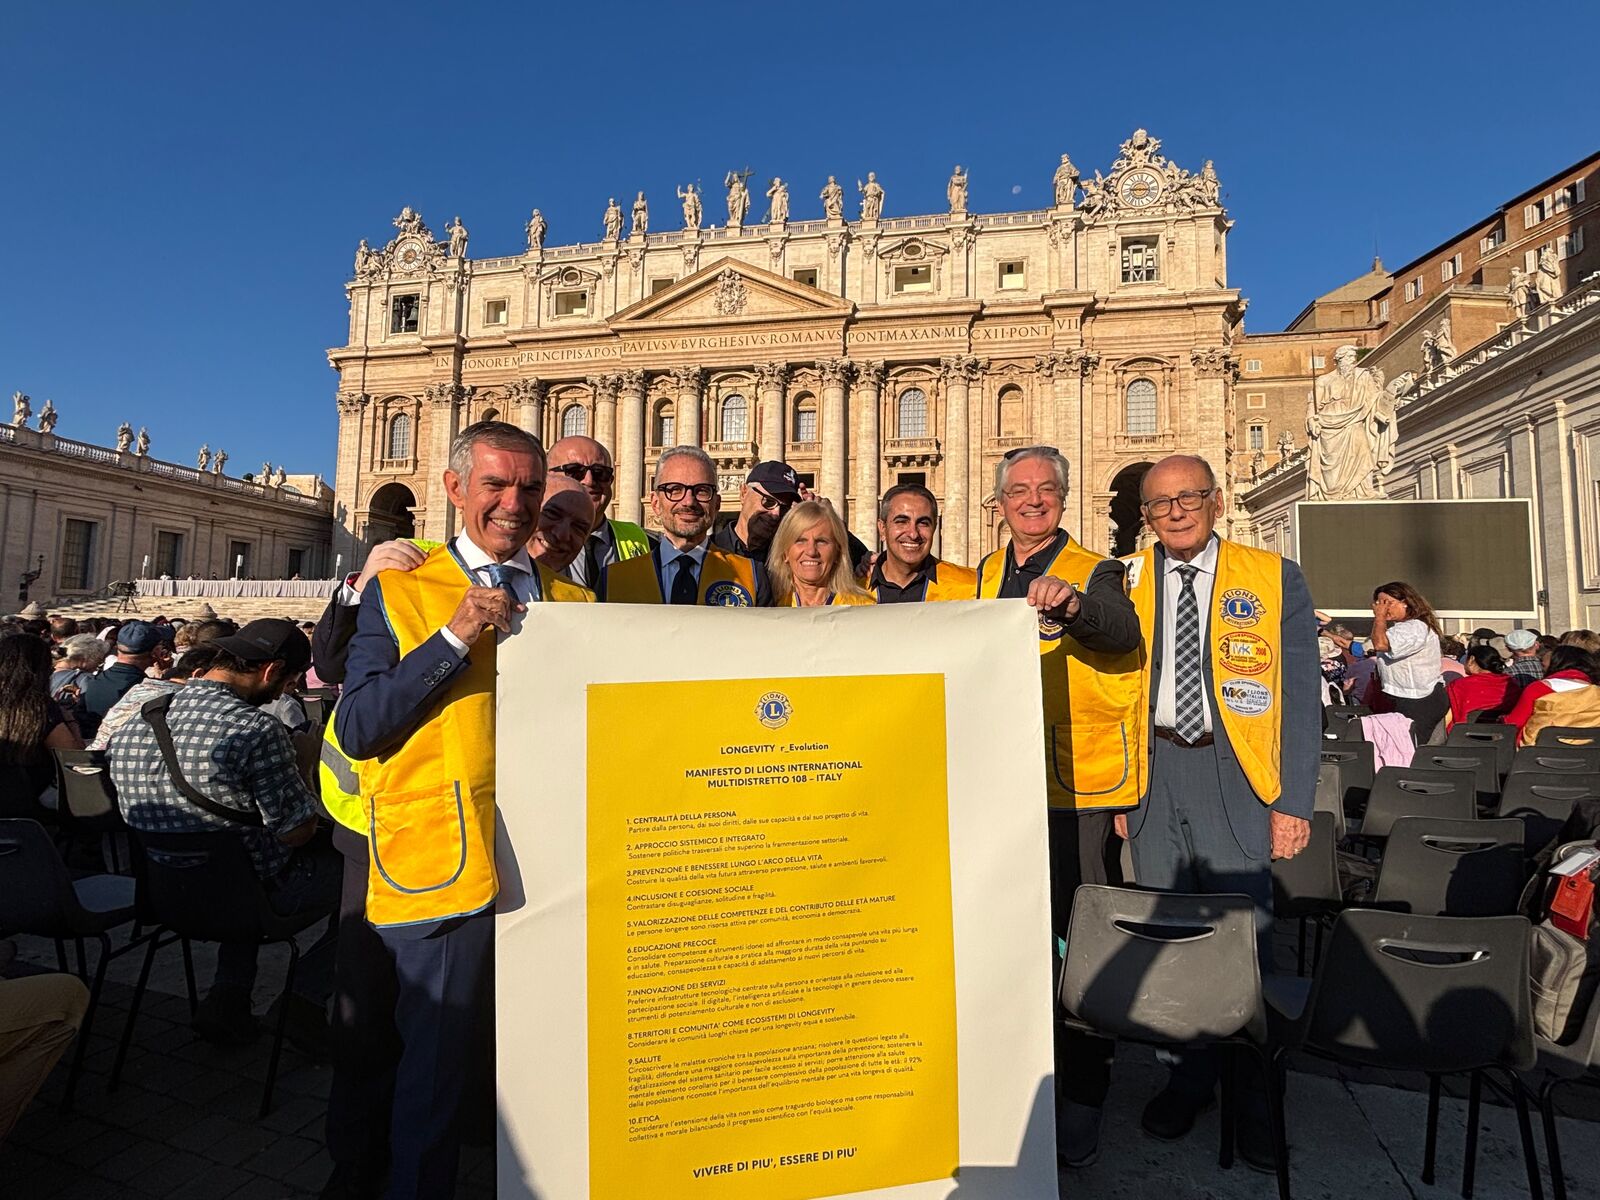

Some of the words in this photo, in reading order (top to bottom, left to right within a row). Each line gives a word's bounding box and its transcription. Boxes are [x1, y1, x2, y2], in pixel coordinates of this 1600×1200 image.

[435, 357, 449, 367] IN
[461, 357, 520, 369] HONOREM
[770, 330, 842, 343] ROMANVS
[1057, 318, 1079, 330] VII
[717, 585, 740, 593] LIONS
[1227, 590, 1254, 600] LIONS
[724, 594, 735, 606] L
[1234, 601, 1248, 615] L
[763, 693, 785, 701] LIONS
[769, 703, 780, 716] L
[720, 744, 775, 755] LONGEVITY
[780, 742, 829, 753] r_Evolution
[685, 766, 742, 778] MANIFESTO
[744, 766, 754, 775] DI
[756, 764, 785, 774] LIONS
[787, 760, 862, 772] INTERNATIONAL
[707, 775, 790, 788] MULTIDISTRETTO
[791, 774, 807, 783] 108
[816, 772, 842, 782] ITALY
[628, 825, 650, 834] Partire
[651, 824, 667, 832] dalla
[696, 821, 707, 829] dai
[742, 817, 757, 825] dalle
[770, 815, 795, 824] capacità
[824, 812, 850, 820] progetto
[850, 810, 857, 818] di
[633, 813, 678, 824] CENTRALITÀ
[679, 812, 702, 821] DELLA
[703, 810, 737, 819] PERSONA
[626, 843, 633, 851] 2.
[633, 840, 678, 851] APPROCCIO
[679, 837, 718, 847] SISTEMICO
[719, 836, 724, 844] E
[725, 833, 766, 843] INTEGRATO
[628, 852, 661, 860] Sostenere
[662, 848, 691, 858] politiche
[691, 845, 723, 854] trasversali
[723, 844, 736, 852] che
[737, 842, 764, 851] superino
[772, 839, 820, 848] frammentazione
[626, 865, 682, 877] 3.PREVENZIONE
[690, 861, 728, 872] BENESSERE
[730, 859, 756, 868] LUNGO
[784, 855, 806, 863] DELLA
[679, 890, 684, 898] E
[685, 887, 722, 898] COESIONE
[724, 884, 754, 894] SOCIALE
[626, 902, 666, 911] Contrastare
[715, 894, 745, 903] solitudine
[626, 915, 696, 928] 5.VALORIZZAZIONE
[697, 912, 719, 921] DELLE
[720, 908, 768, 919] COMPETENZE
[775, 906, 788, 914] DEL
[789, 901, 834, 912] CONTRIBUTO
[835, 898, 854, 907] DELLE
[855, 897, 868, 905] ETÀ
[869, 894, 895, 903] MATURE
[636, 928, 663, 937] persone
[664, 925, 689, 934] longeve
[729, 919, 747, 927] attiva
[747, 918, 759, 926] per
[791, 911, 821, 920] economia
[626, 941, 681, 954] 6.EDUCAZIONE
[683, 938, 716, 948] PRECOCE
[627, 983, 685, 997] 7.INNOVAZIONE
[686, 982, 698, 990] DEI
[699, 979, 726, 989] SERVIZI
[627, 1012, 659, 1023] strumenti
[660, 1011, 667, 1019] di
[668, 1007, 716, 1019] potenziamento
[716, 1002, 744, 1012] culturale
[627, 1028, 671, 1040] 8.TERRITORI
[721, 1019, 744, 1028] COME
[745, 1013, 787, 1025] ECOSISTEMI
[788, 1012, 796, 1020] DI
[796, 1007, 835, 1019] LONGEVITY
[627, 1038, 668, 1049] Considerare
[676, 1031, 707, 1043] comunità
[708, 1029, 728, 1038] luoghi
[728, 1028, 749, 1036] chiave
[750, 1026, 761, 1034] per
[774, 1020, 802, 1030] longevity
[627, 1054, 661, 1066] 9.SALUTE
[628, 1114, 660, 1125] 10.ETICA
[628, 1132, 658, 1142] collettiva
[665, 1127, 688, 1136] morale
[689, 1121, 725, 1133] bilanciando
[732, 1116, 763, 1127] progresso
[764, 1112, 795, 1121] scientifico
[692, 1163, 733, 1178] VIVERE
[736, 1160, 748, 1171] DI
[779, 1152, 819, 1166] ESSERE
[822, 1150, 833, 1160] DI
